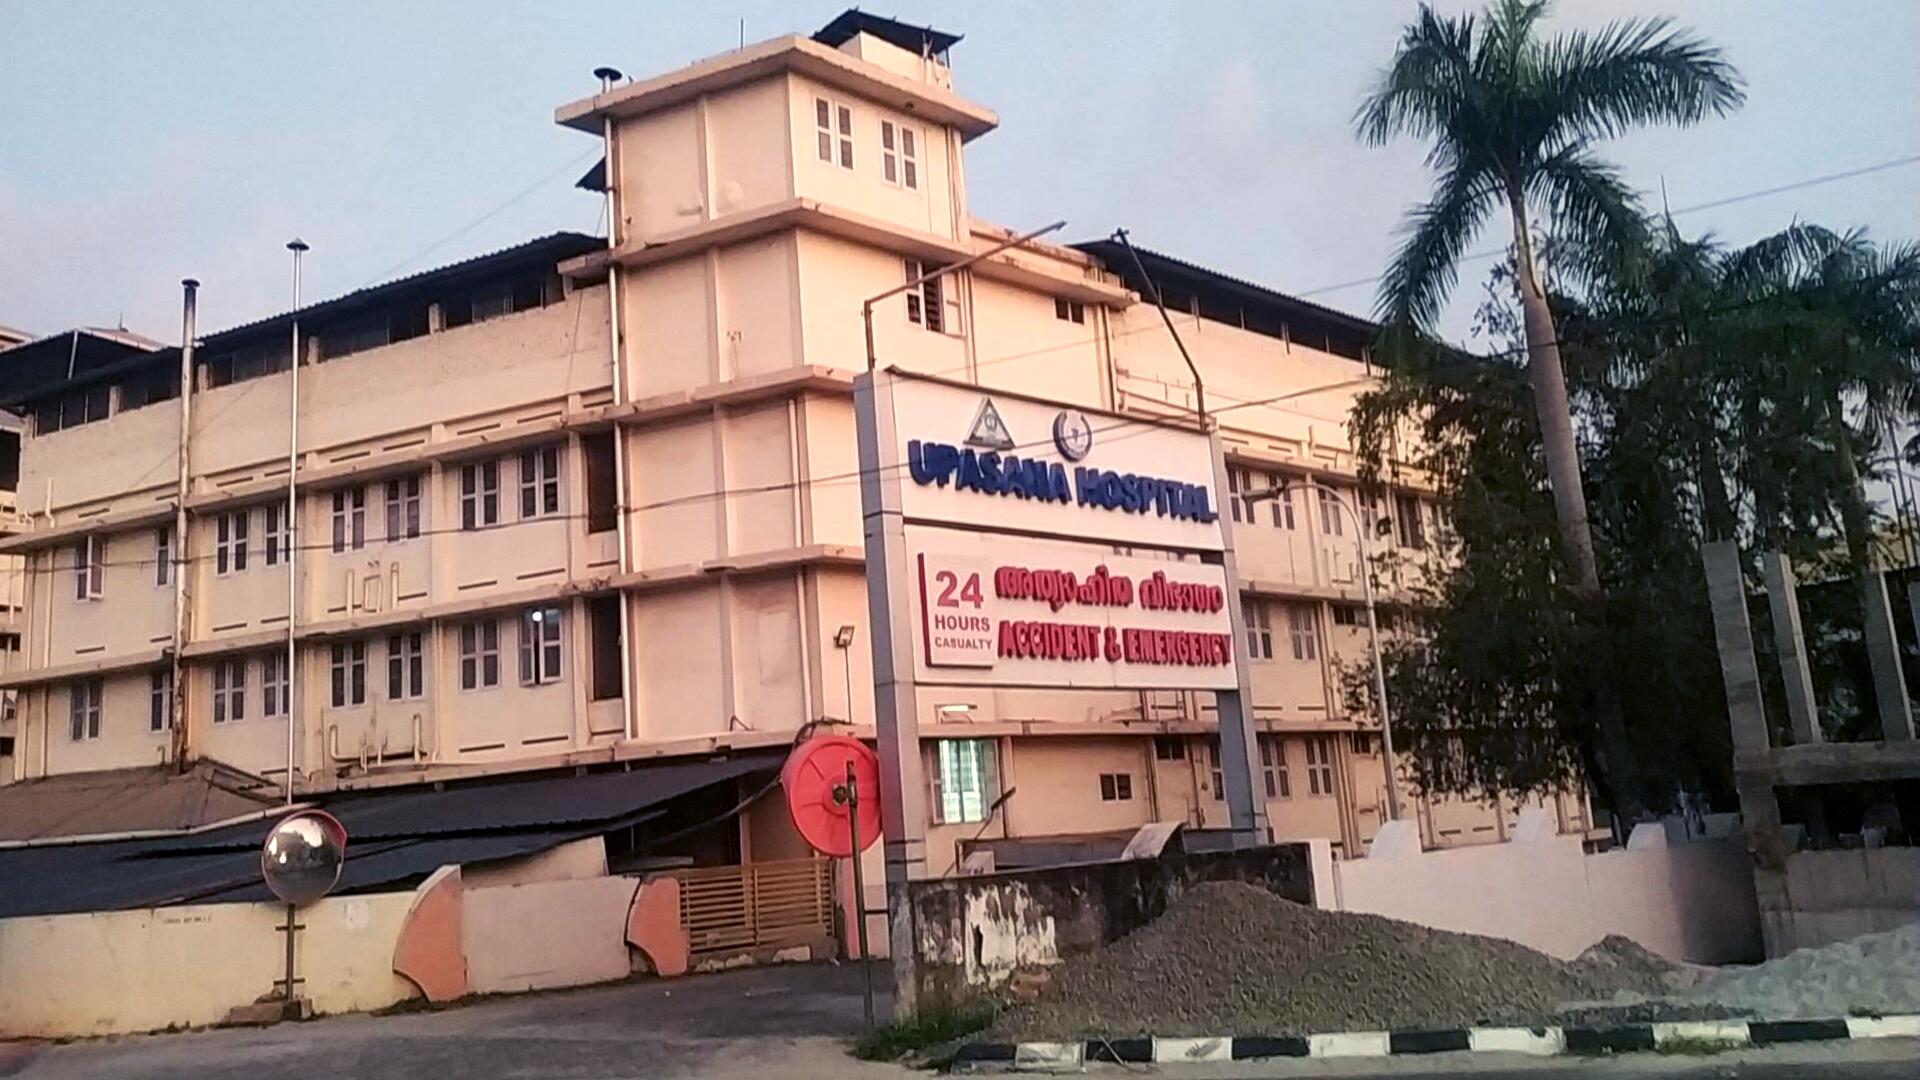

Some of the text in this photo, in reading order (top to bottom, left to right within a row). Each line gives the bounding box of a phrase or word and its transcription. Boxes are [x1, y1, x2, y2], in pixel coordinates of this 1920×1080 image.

[907, 439, 1218, 523] UPASANA HOSPITAL
[935, 570, 984, 609] 24
[994, 564, 1224, 614] അത്യാഹിത വിഭാഗം
[934, 613, 991, 632] HOURS
[934, 636, 993, 650] CASUALTY
[997, 620, 1231, 667] ACCIDENT & EMERGENCY
